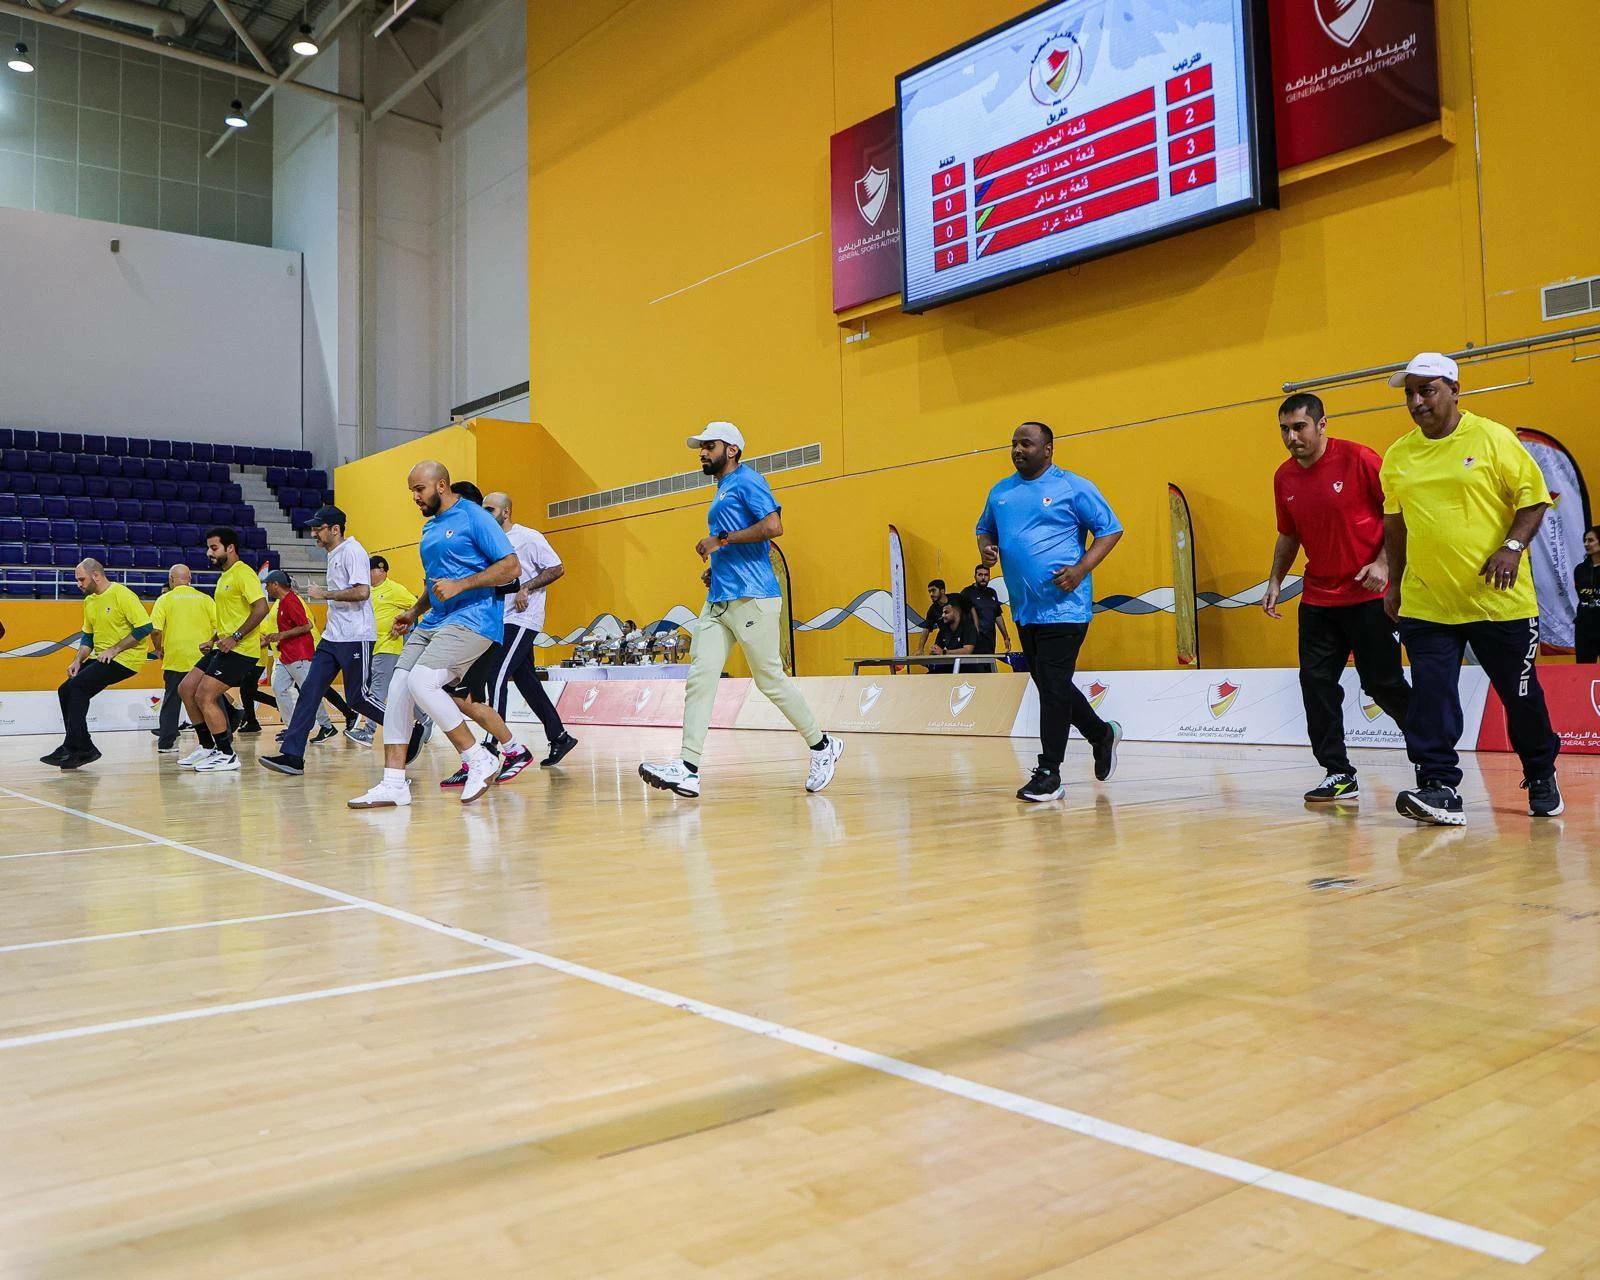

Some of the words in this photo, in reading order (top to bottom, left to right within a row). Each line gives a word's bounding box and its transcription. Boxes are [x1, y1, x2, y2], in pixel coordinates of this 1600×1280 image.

[1330, 50, 1372, 75] العامة
[1285, 67, 1327, 92] للرياضة
[1286, 82, 1326, 103] GENERAL
[1327, 67, 1363, 89] SPORTS
[1364, 47, 1418, 75] AUTHORITY
[1183, 78, 1191, 93] 1
[1046, 106, 1069, 126] الفريق
[1185, 108, 1194, 124] 2
[1067, 118, 1087, 137] قلعة
[1032, 129, 1065, 154] البحرين
[1186, 138, 1195, 155] 3
[944, 174, 951, 187] 0
[1187, 168, 1197, 184] 4
[945, 199, 952, 212] 0
[946, 225, 953, 238] 0
[947, 251, 954, 264] 0
